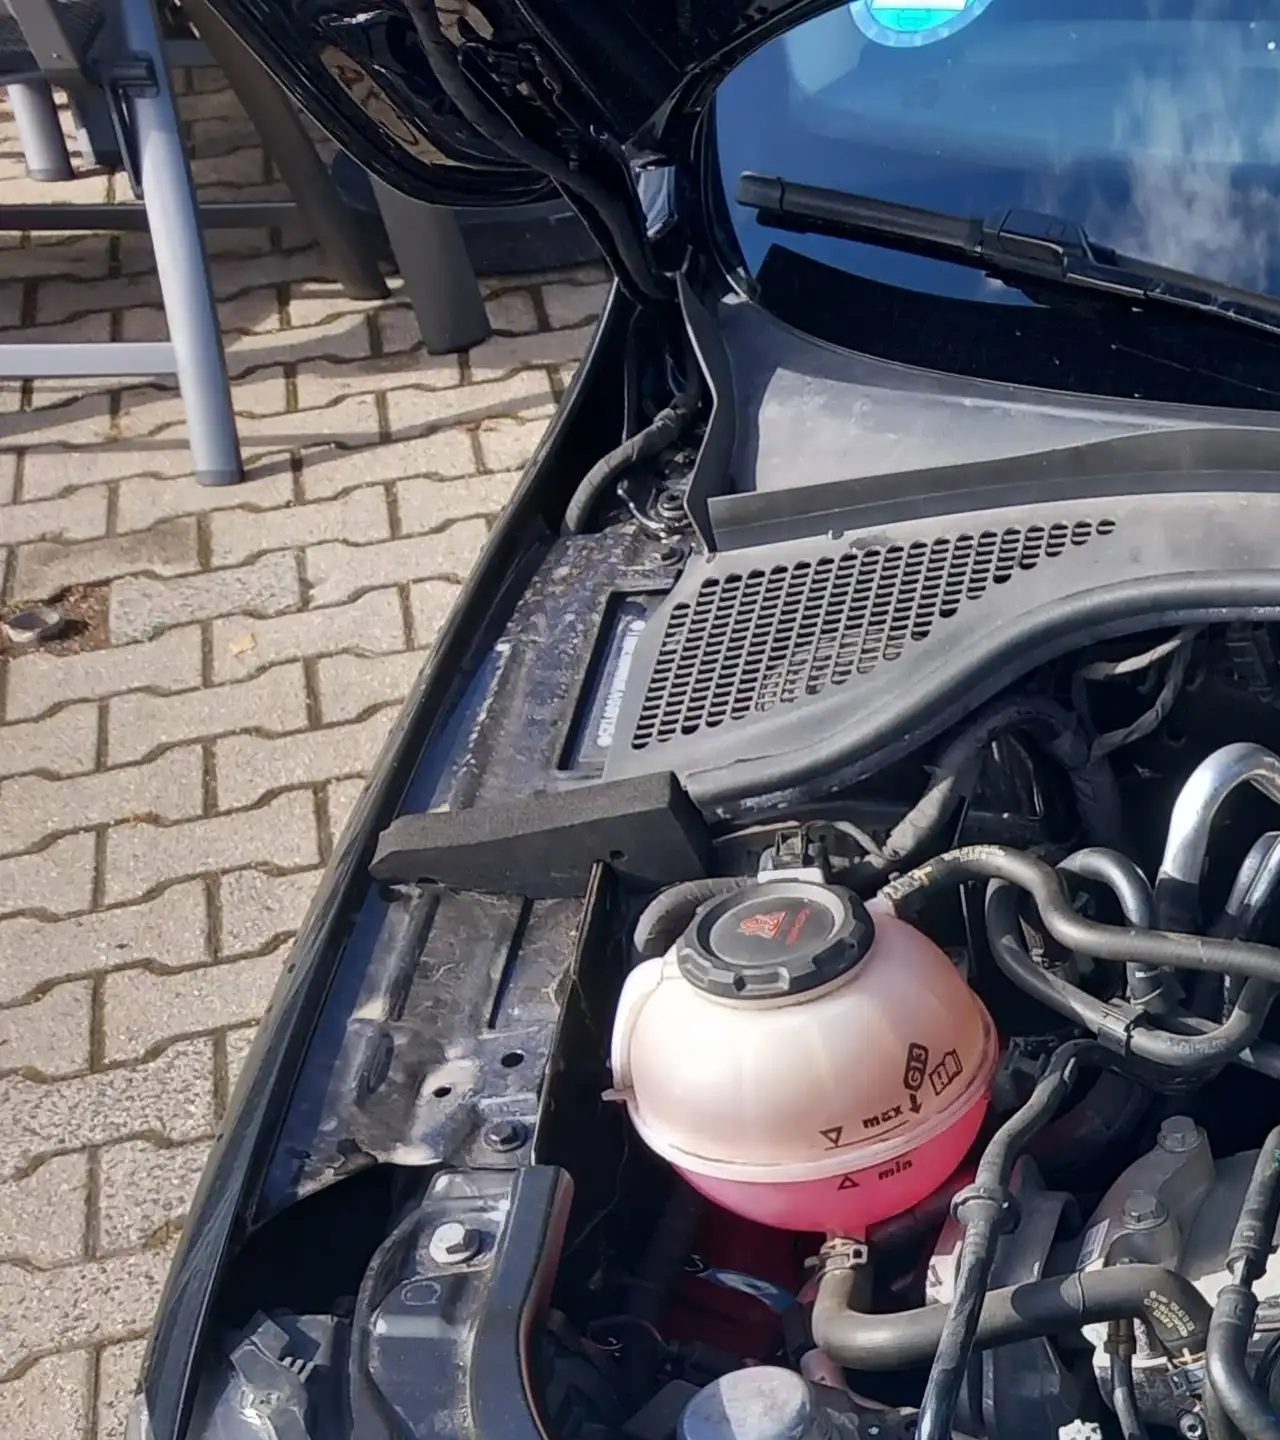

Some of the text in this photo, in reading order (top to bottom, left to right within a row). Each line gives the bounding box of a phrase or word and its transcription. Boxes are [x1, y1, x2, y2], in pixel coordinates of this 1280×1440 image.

[908, 1047, 926, 1086] G13
[862, 1104, 904, 1129] max
[878, 1160, 913, 1180] min
